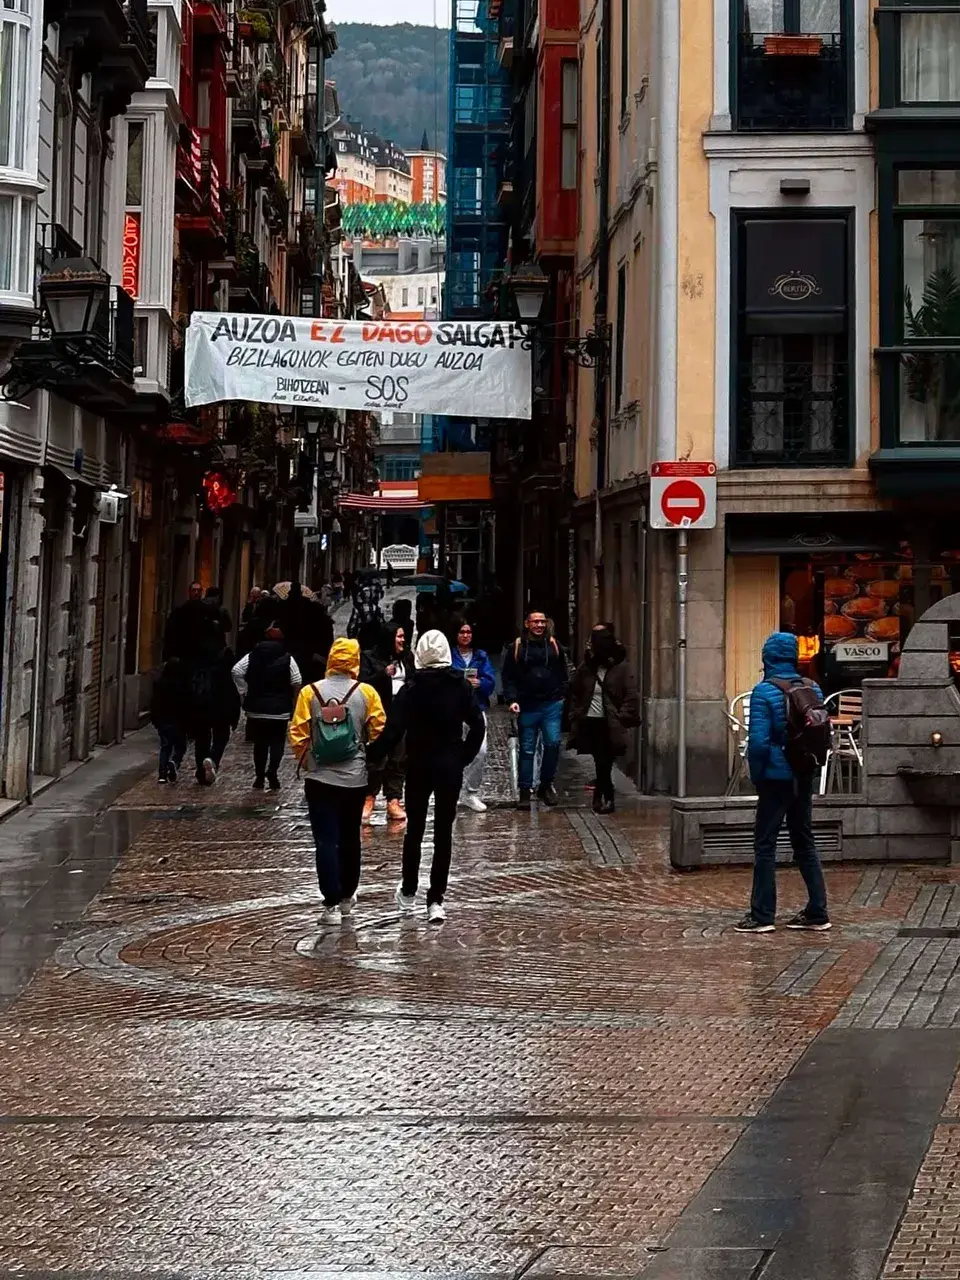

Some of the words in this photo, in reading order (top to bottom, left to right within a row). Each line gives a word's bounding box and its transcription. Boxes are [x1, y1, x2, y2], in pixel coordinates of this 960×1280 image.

[210, 317, 297, 344] AUZOA
[310, 320, 346, 344] EZ
[362, 322, 433, 346] DAGO
[226, 346, 333, 369] BIZILAGUNOK
[337, 350, 385, 369] EGITEN
[390, 351, 428, 369] DUGU
[434, 351, 485, 372] AUZOA
[276, 376, 330, 396] BIHOTZEAN
[364, 374, 410, 402] SOS
[843, 646, 881, 657] VASCO
